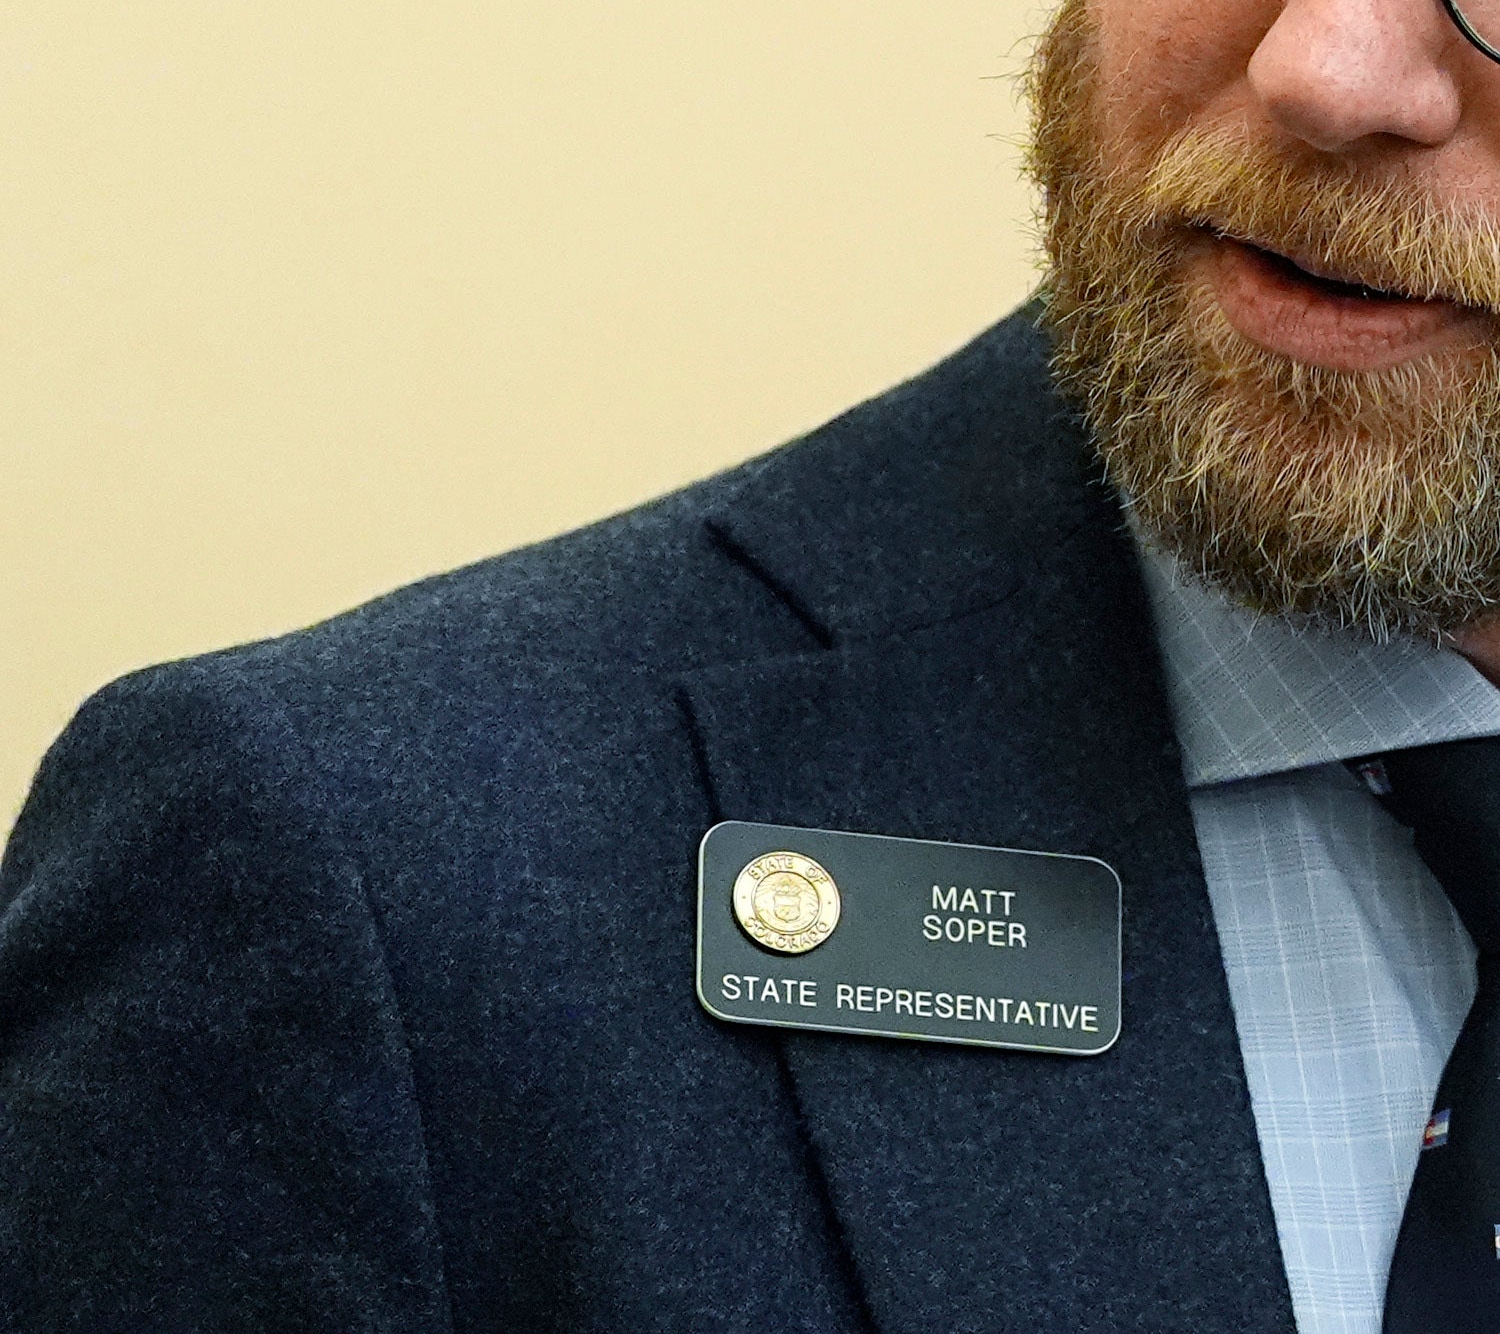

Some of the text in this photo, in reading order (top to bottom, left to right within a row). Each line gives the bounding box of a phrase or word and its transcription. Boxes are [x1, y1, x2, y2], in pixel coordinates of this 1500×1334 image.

[747, 856, 829, 884] STATE OF
[931, 885, 1016, 917] MATT
[922, 915, 1027, 949] SOPER
[721, 974, 1099, 1033] STATE REPRESENTATIVE
